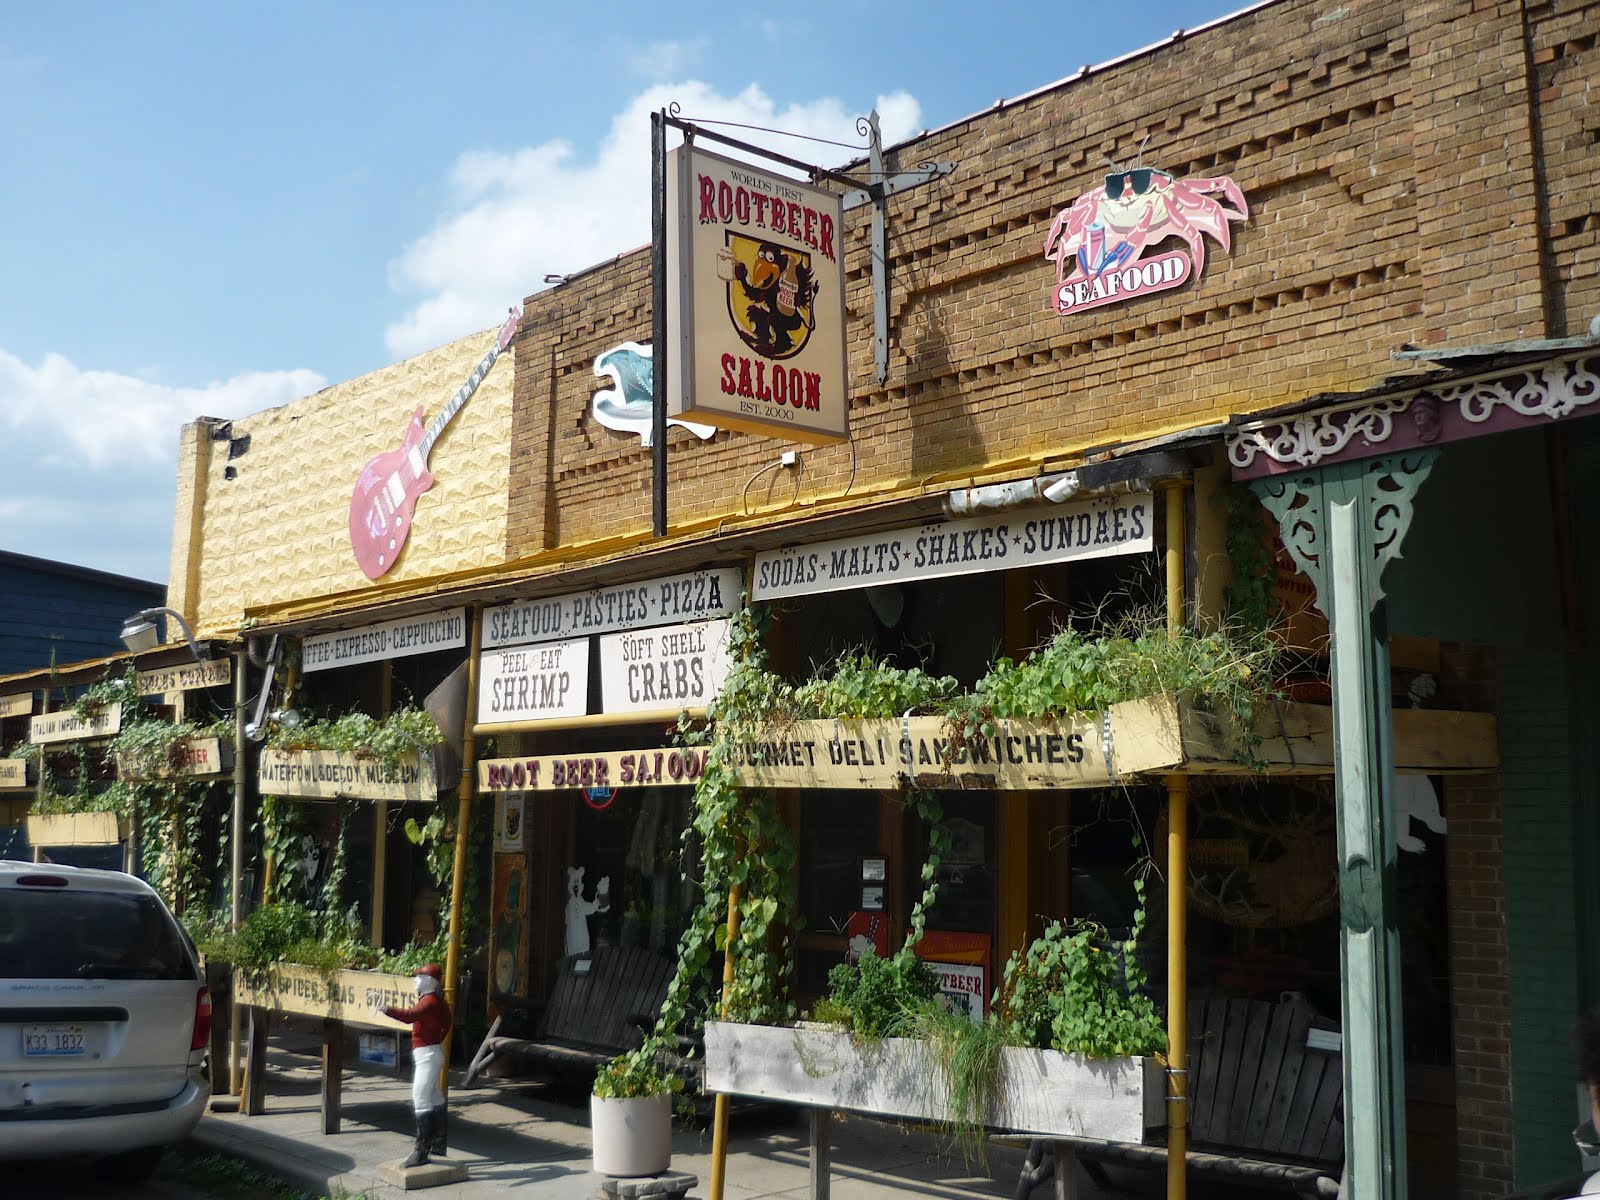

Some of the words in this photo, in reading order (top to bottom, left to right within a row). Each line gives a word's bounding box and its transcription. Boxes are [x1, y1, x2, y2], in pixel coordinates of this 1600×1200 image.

[731, 170, 772, 193] WORLDS
[776, 184, 804, 202] FIRST
[698, 173, 836, 264] ROOTBEER
[1058, 257, 1185, 311] SEAFOOD
[721, 353, 821, 412] SALOON
[740, 401, 762, 416] EST.
[765, 405, 794, 421] 2000
[759, 552, 818, 590] SODAS
[829, 540, 901, 580] MALTS
[914, 525, 1009, 568] SHAKES
[1023, 504, 1146, 554] SUNDAES
[491, 602, 562, 641] SEAFOOD
[572, 587, 649, 629] PASTIES
[660, 575, 724, 617] PIZZA
[335, 630, 387, 660] EXPRESSO
[393, 616, 461, 650] CAPPUCCINO
[623, 637, 654, 662] SOFT
[662, 630, 706, 657] SHELL
[502, 652, 528, 674] PEEL
[540, 649, 562, 671] EAT
[628, 656, 704, 703] CRABS
[492, 670, 570, 713] SHRIMP
[487, 760, 540, 788] ROOT
[551, 757, 609, 786] BEER
[830, 738, 886, 766] DELI
[55, 1034, 84, 1050] 1832
